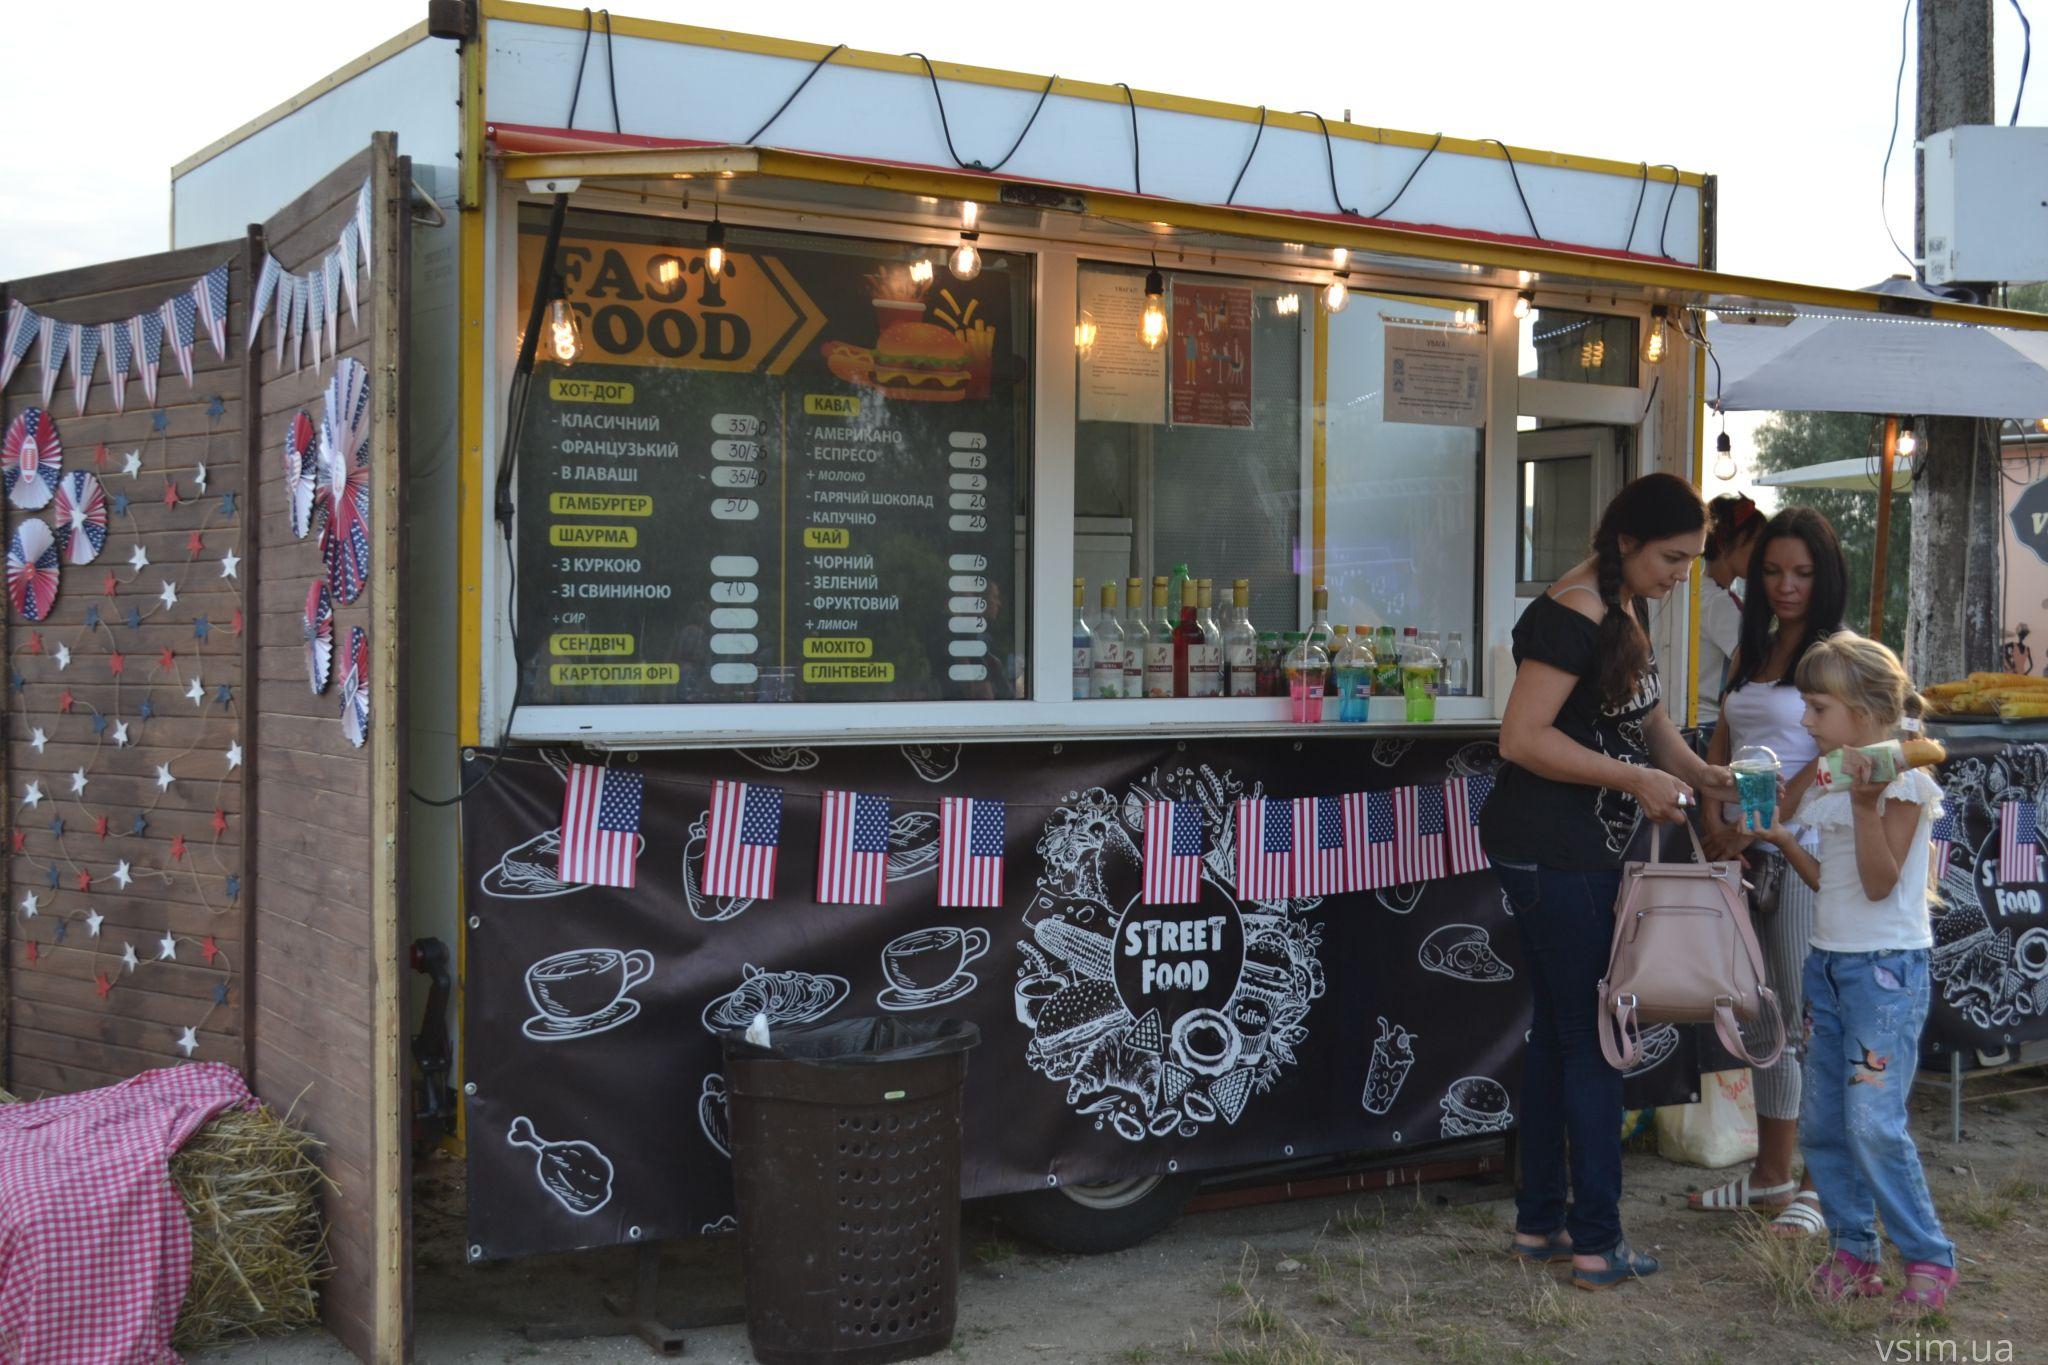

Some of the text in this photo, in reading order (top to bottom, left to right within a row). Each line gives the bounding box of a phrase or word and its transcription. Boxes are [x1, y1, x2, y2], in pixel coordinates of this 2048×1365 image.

[556, 246, 736, 307] FAST
[559, 383, 626, 400] ХОТ-ДОГ
[815, 398, 852, 412] КАВА
[561, 413, 660, 431] КЛАСИЧНИЙ
[814, 426, 902, 444] АМЕРИКАНО
[561, 439, 679, 458] ФРАНЦУЗЬКИЙ
[815, 447, 877, 463] ЕСПРЕСО
[561, 466, 638, 482] В ЛАВАШІ
[818, 470, 866, 482] МОЛОКО
[559, 496, 648, 512] ГАМБУРГЕР
[814, 490, 934, 509] ГАРЯЧИЙ ШОКОЛАД
[813, 512, 876, 525] КАПУЧІНО
[559, 529, 629, 543] ШАУРМА
[812, 529, 842, 544] ЧАЙ
[574, 558, 641, 573] КУРКОЮ
[814, 554, 874, 569] ЧОРНИЙ
[813, 574, 878, 590] ЗЕЛЕНИЙ
[579, 584, 671, 599] СВИНИНОЮ
[813, 595, 900, 611] ФРУКТОВИЙ
[562, 612, 586, 624] СИР
[817, 619, 858, 631] ЛИМОН
[559, 637, 626, 653] СЕНДВІЧ
[811, 641, 866, 654] МОХІТО
[559, 667, 673, 681] КАРТОПЛЯ ФРІ
[811, 664, 887, 679] ГЛІНТВЕЙН
[1995, 888, 2041, 916] FOOD
[1124, 915, 1227, 957] STREET
[1142, 959, 1210, 994] FOOD
[1235, 1004, 1267, 1026] Coffee
